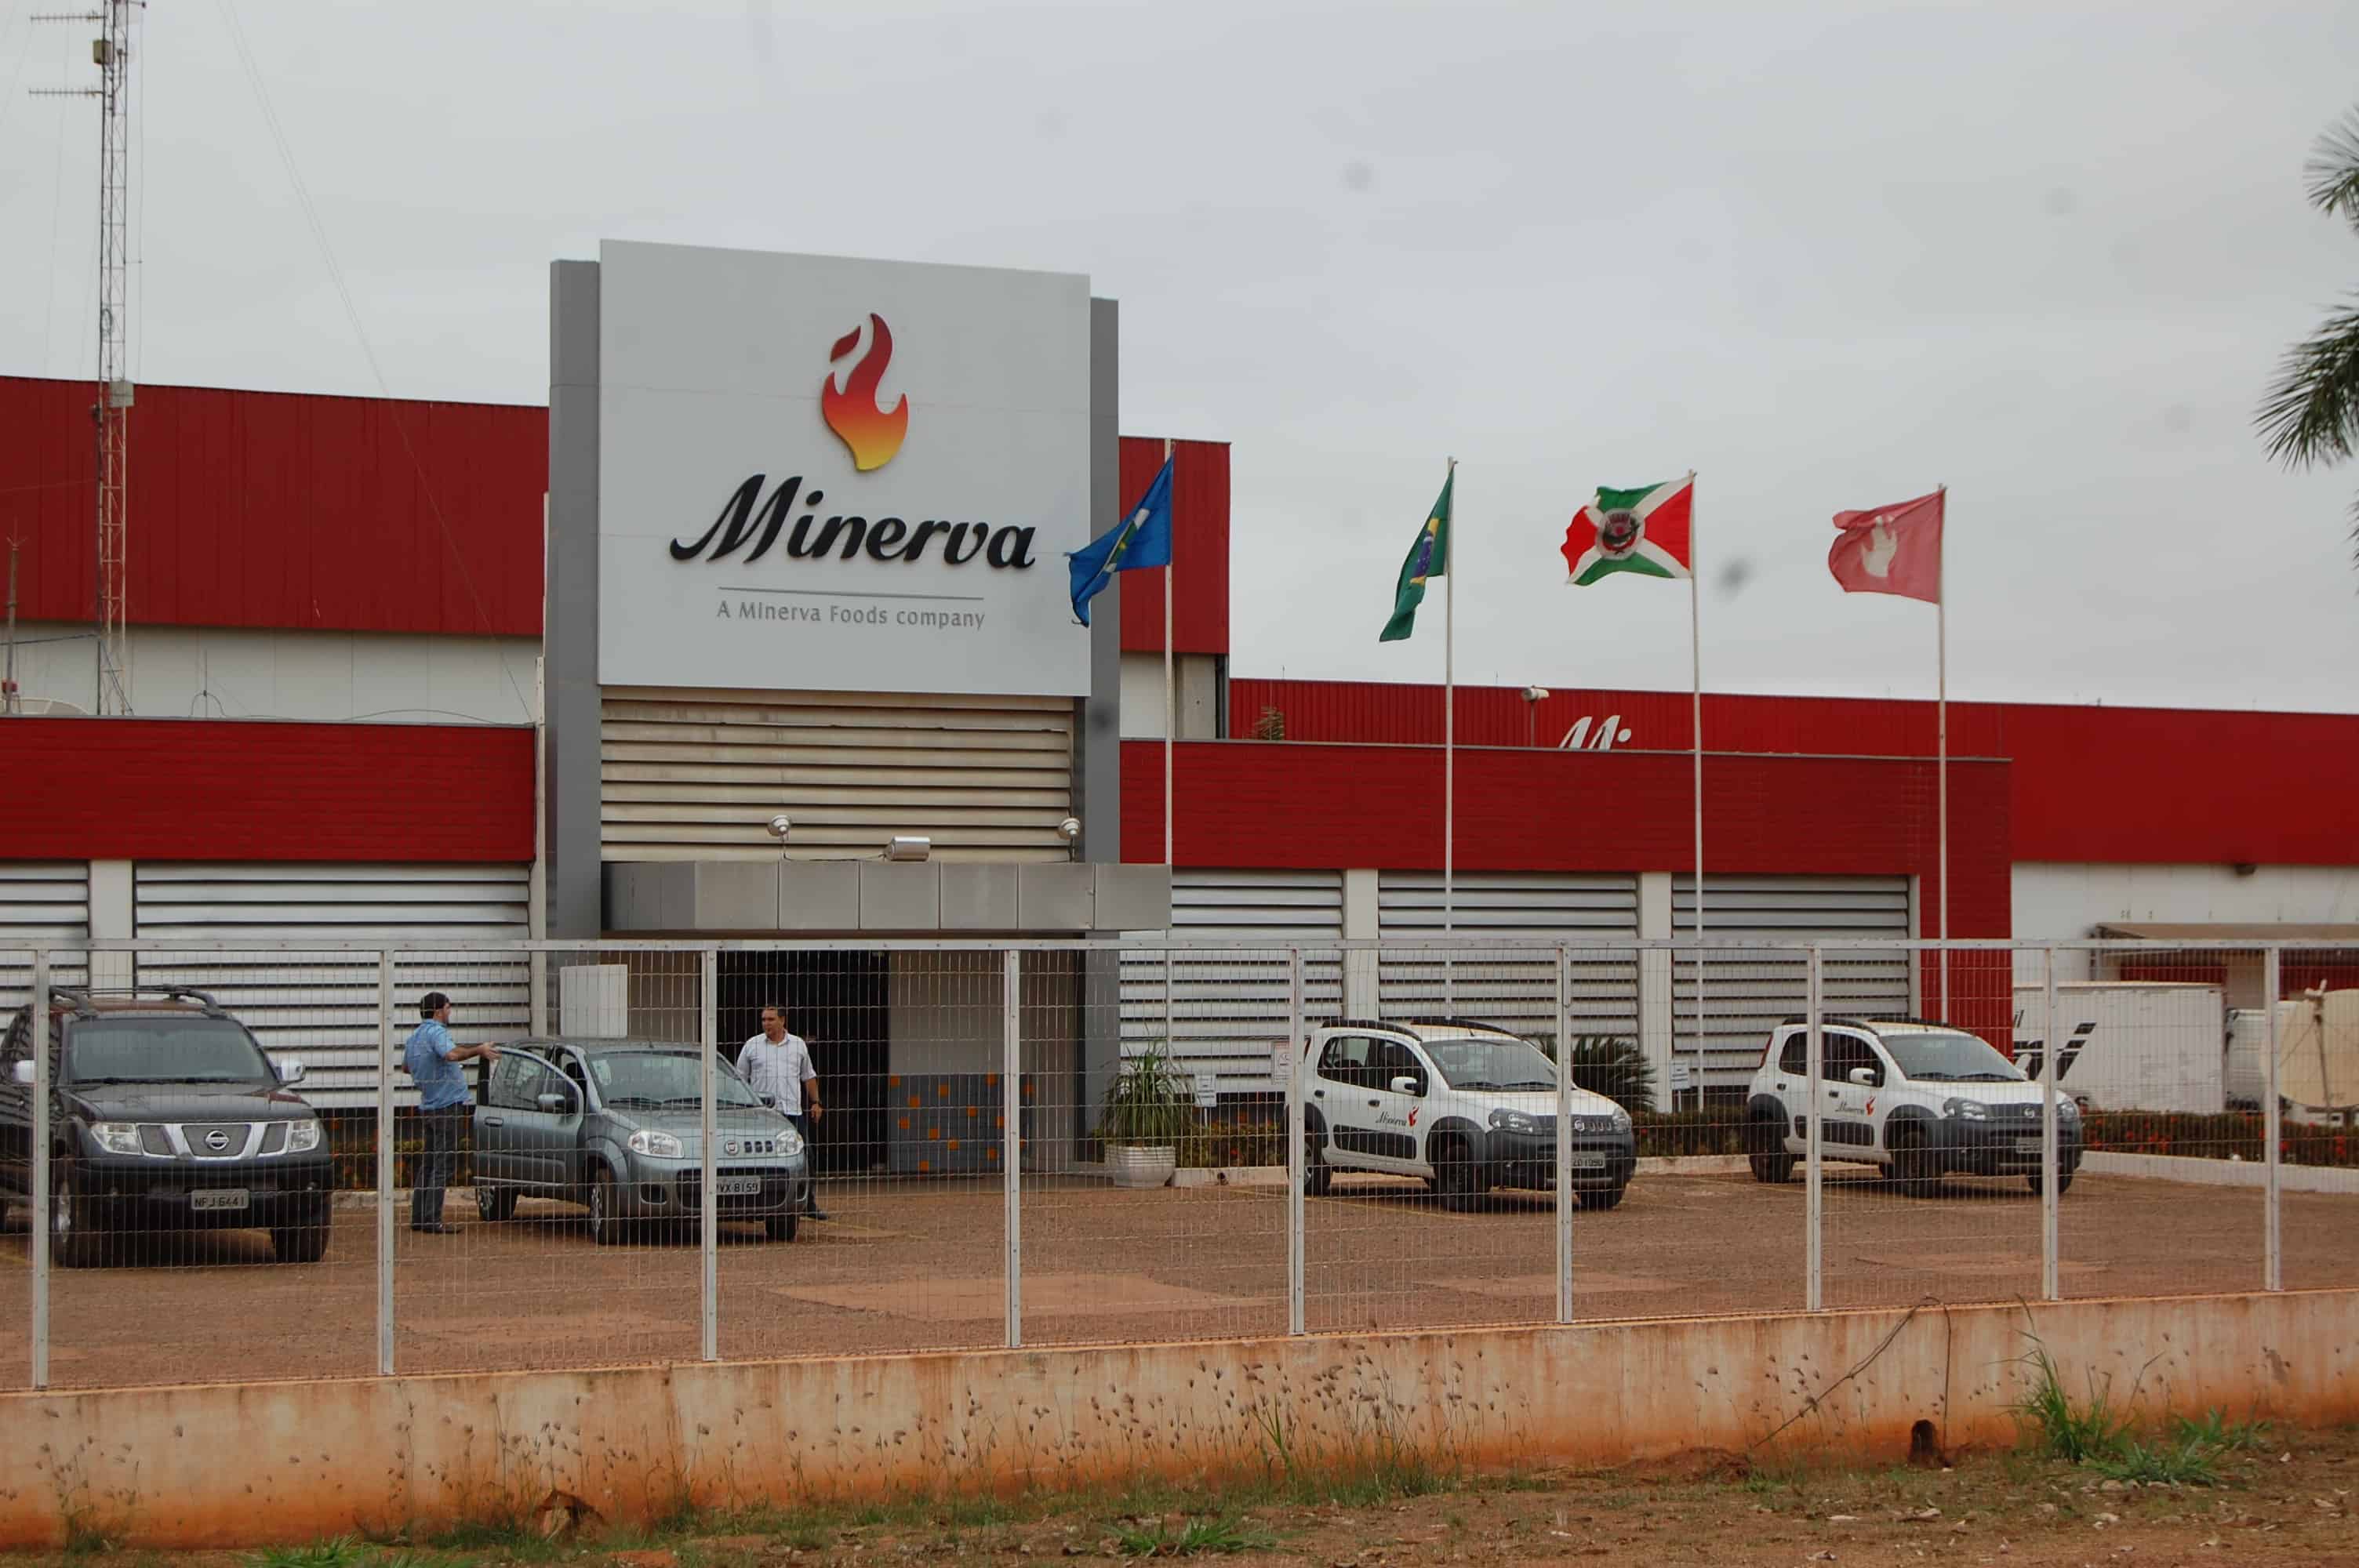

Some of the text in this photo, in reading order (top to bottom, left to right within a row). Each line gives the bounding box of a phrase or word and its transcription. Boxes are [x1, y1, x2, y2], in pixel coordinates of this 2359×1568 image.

[670, 474, 1035, 568] Minerva
[717, 601, 985, 630] A Minerva Foods company
